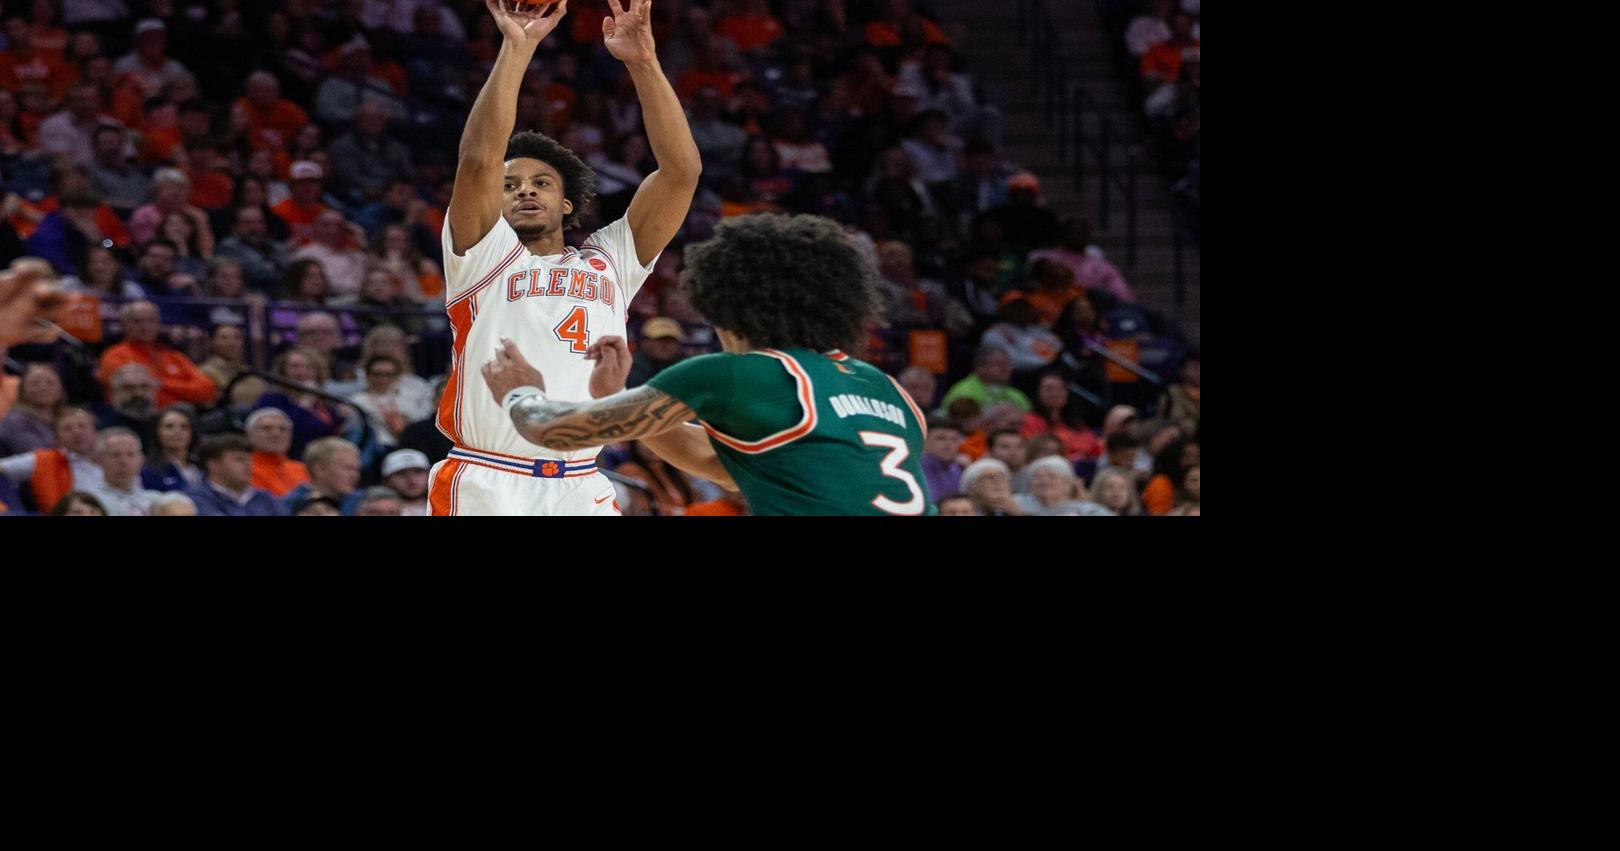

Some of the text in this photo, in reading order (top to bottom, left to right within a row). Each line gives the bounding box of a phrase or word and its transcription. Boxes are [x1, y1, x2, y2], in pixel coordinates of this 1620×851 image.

[507, 268, 615, 307] CLEMSO
[553, 305, 590, 353] 4
[829, 394, 906, 429] DONALDSON
[857, 431, 925, 516] 3
